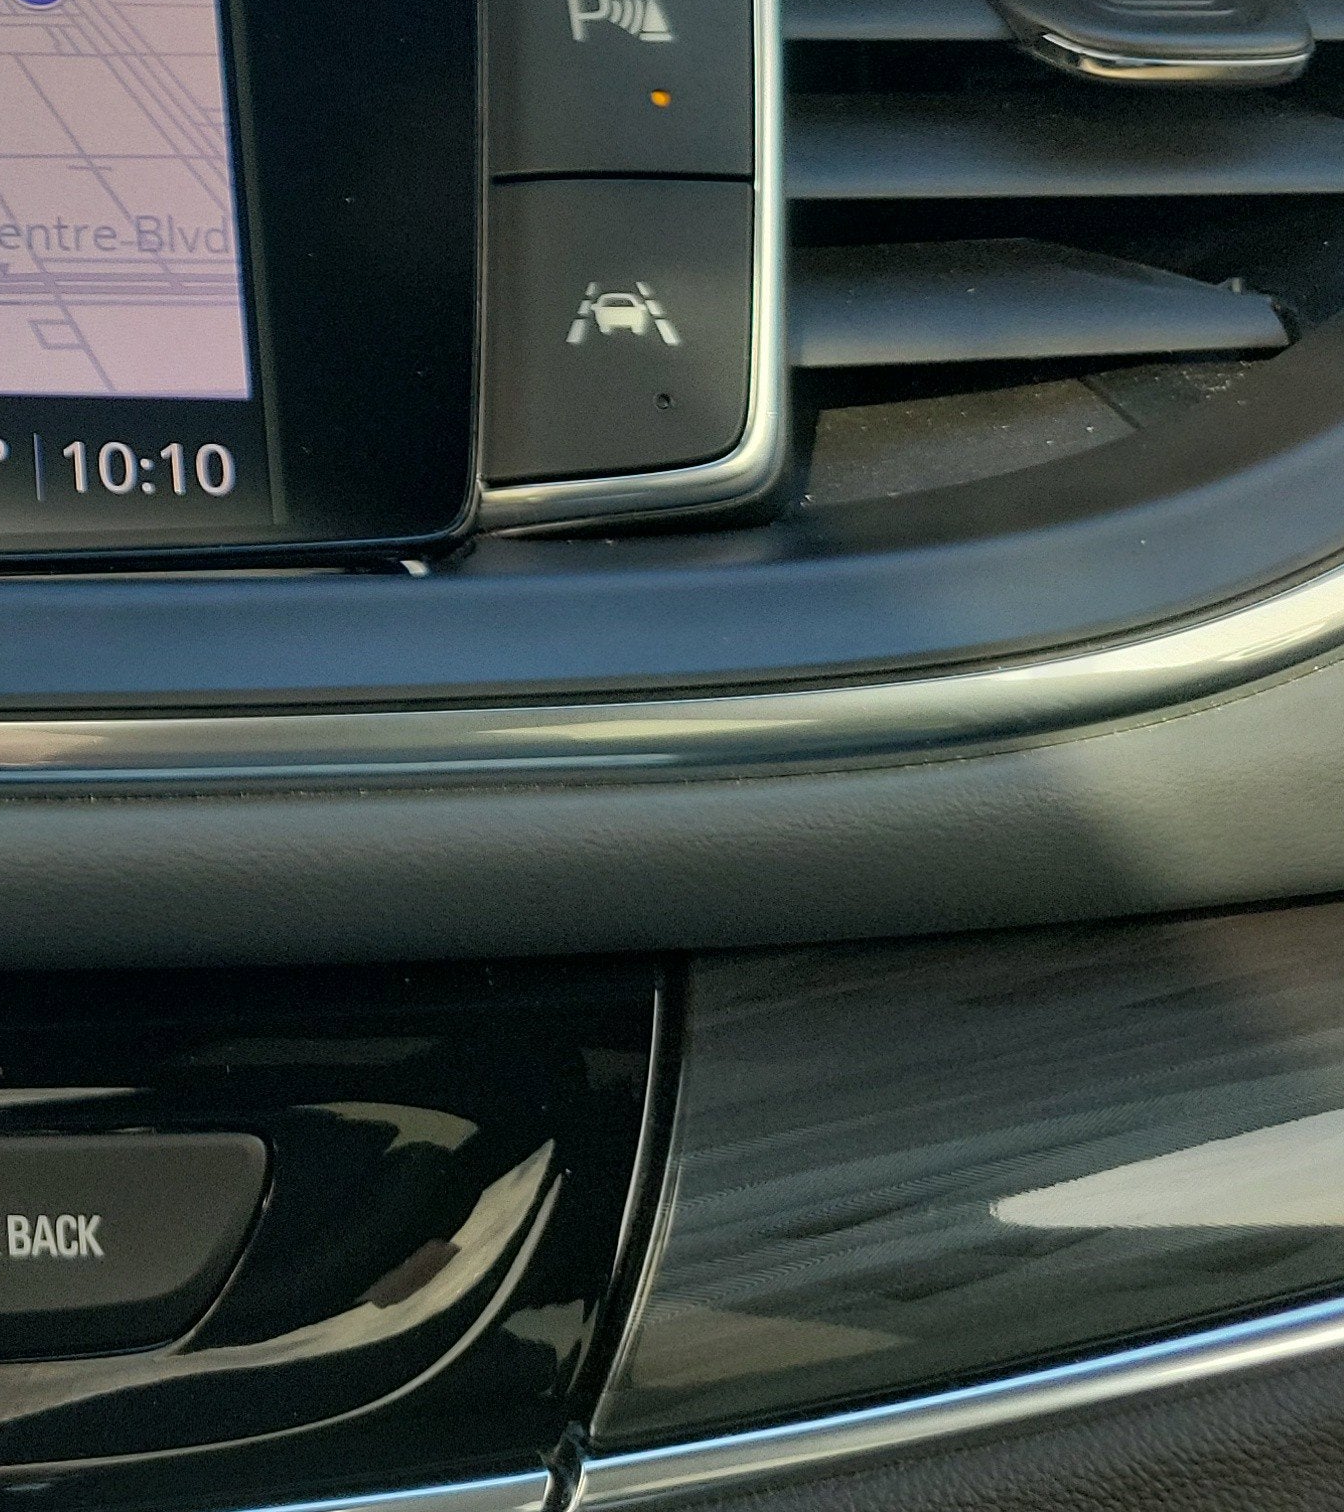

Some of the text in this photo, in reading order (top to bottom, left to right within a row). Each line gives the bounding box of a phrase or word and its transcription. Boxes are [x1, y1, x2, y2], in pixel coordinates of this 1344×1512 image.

[133, 215, 231, 254] Blvd
[63, 441, 237, 497] 10:10
[7, 1214, 104, 1257] BACK
